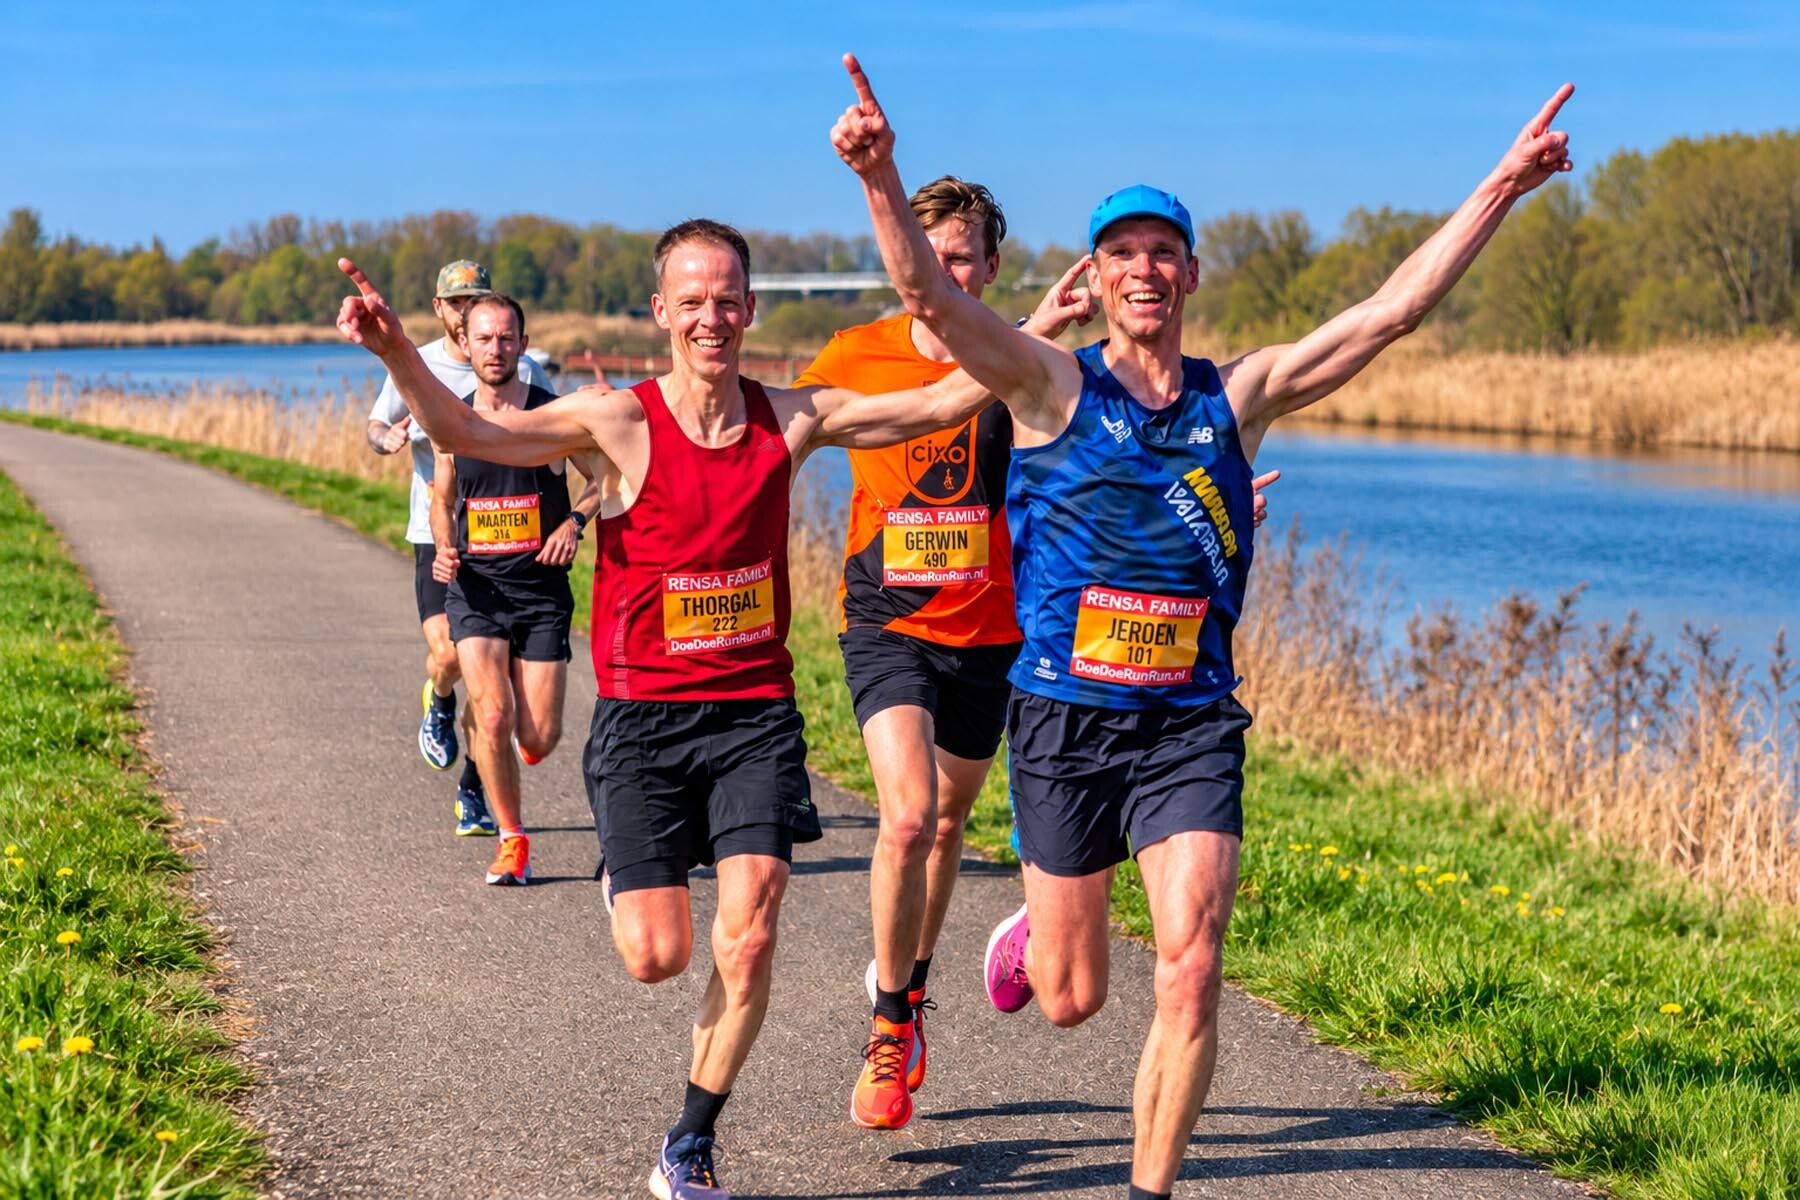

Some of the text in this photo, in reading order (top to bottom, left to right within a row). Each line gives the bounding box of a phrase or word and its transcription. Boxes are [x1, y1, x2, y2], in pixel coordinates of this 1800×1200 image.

[911, 440, 966, 464] cixo
[503, 498, 537, 509] FAMILY
[477, 512, 529, 528] MAARTEN
[887, 509, 986, 524] RENSA FAMILY
[905, 529, 968, 551] GERWIN
[924, 552, 948, 568] 490
[668, 564, 770, 590] RENSA FAMILY
[887, 569, 984, 582] DoeDoeRunRun.nl
[680, 589, 761, 617] THORGAL
[1086, 591, 1204, 616] RENSA FAMILY
[712, 615, 739, 632] 222
[1106, 618, 1177, 646] JEROEN
[671, 626, 771, 652] DoeDoeRunRun.nl
[1127, 646, 1153, 665] 101
[1075, 660, 1186, 682] DoeDoeRunRun.nl
